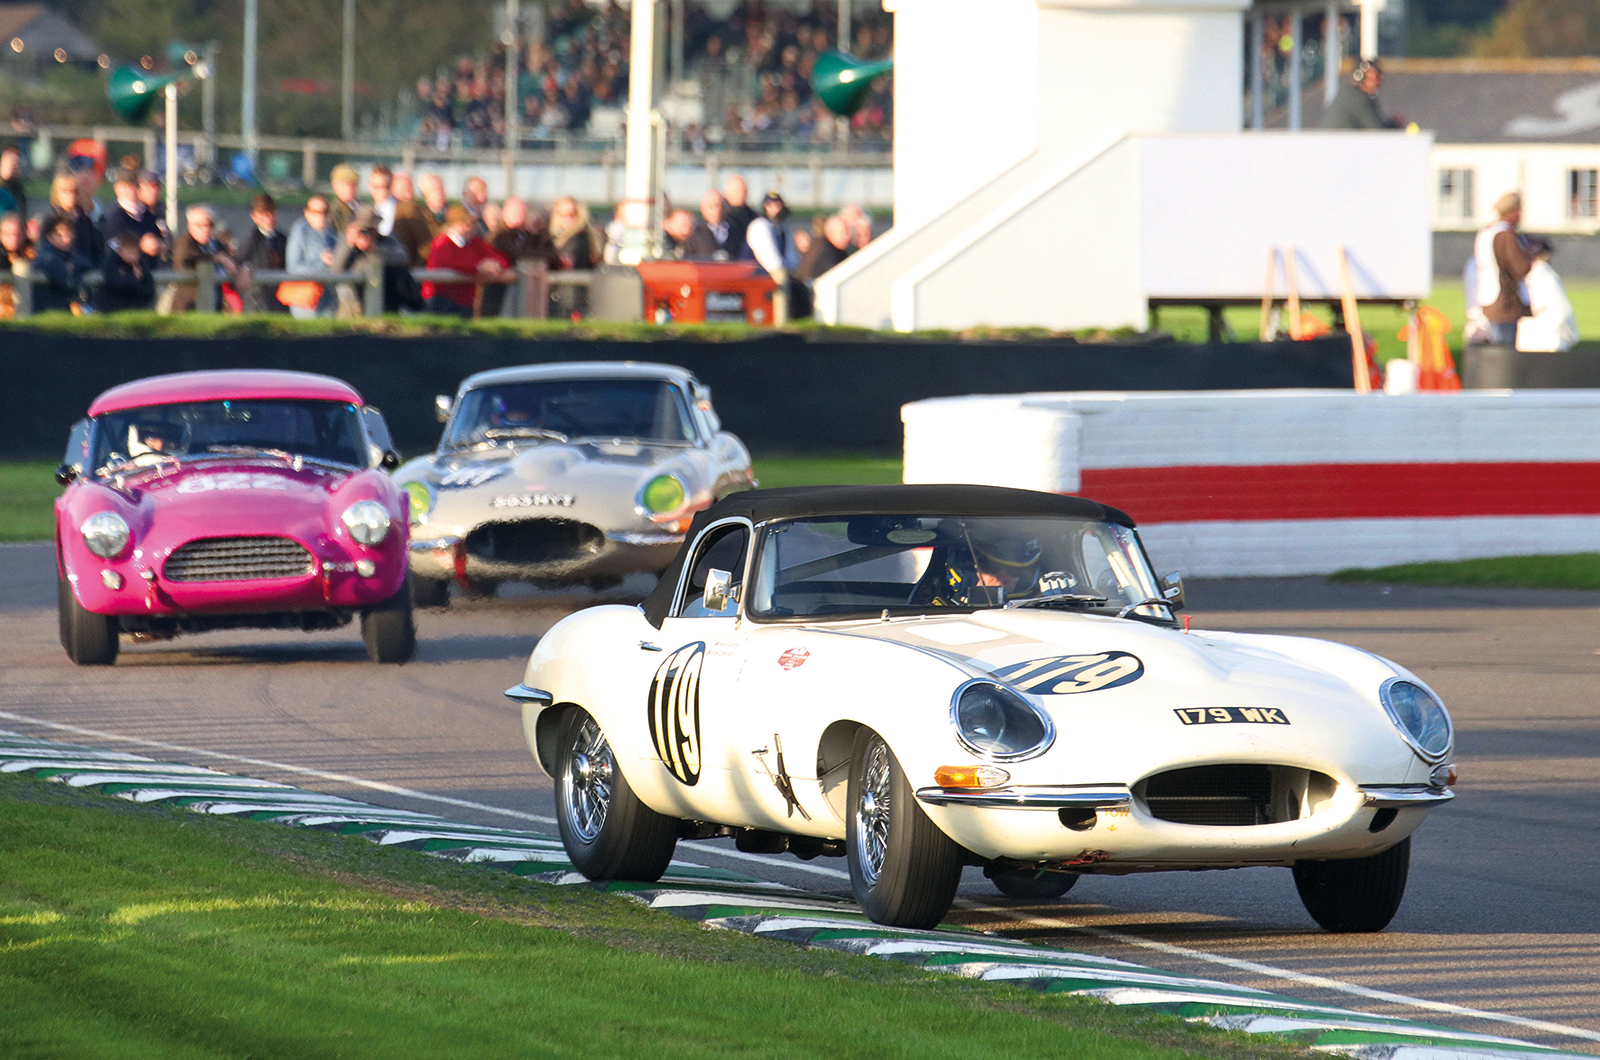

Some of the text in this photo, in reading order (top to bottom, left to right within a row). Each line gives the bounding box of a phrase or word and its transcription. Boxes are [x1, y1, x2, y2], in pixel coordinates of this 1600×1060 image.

[1000, 654, 1139, 693] 179
[655, 643, 702, 782] 179
[1177, 708, 1286, 724] 179 WK
[1104, 807, 1131, 818] TOW
